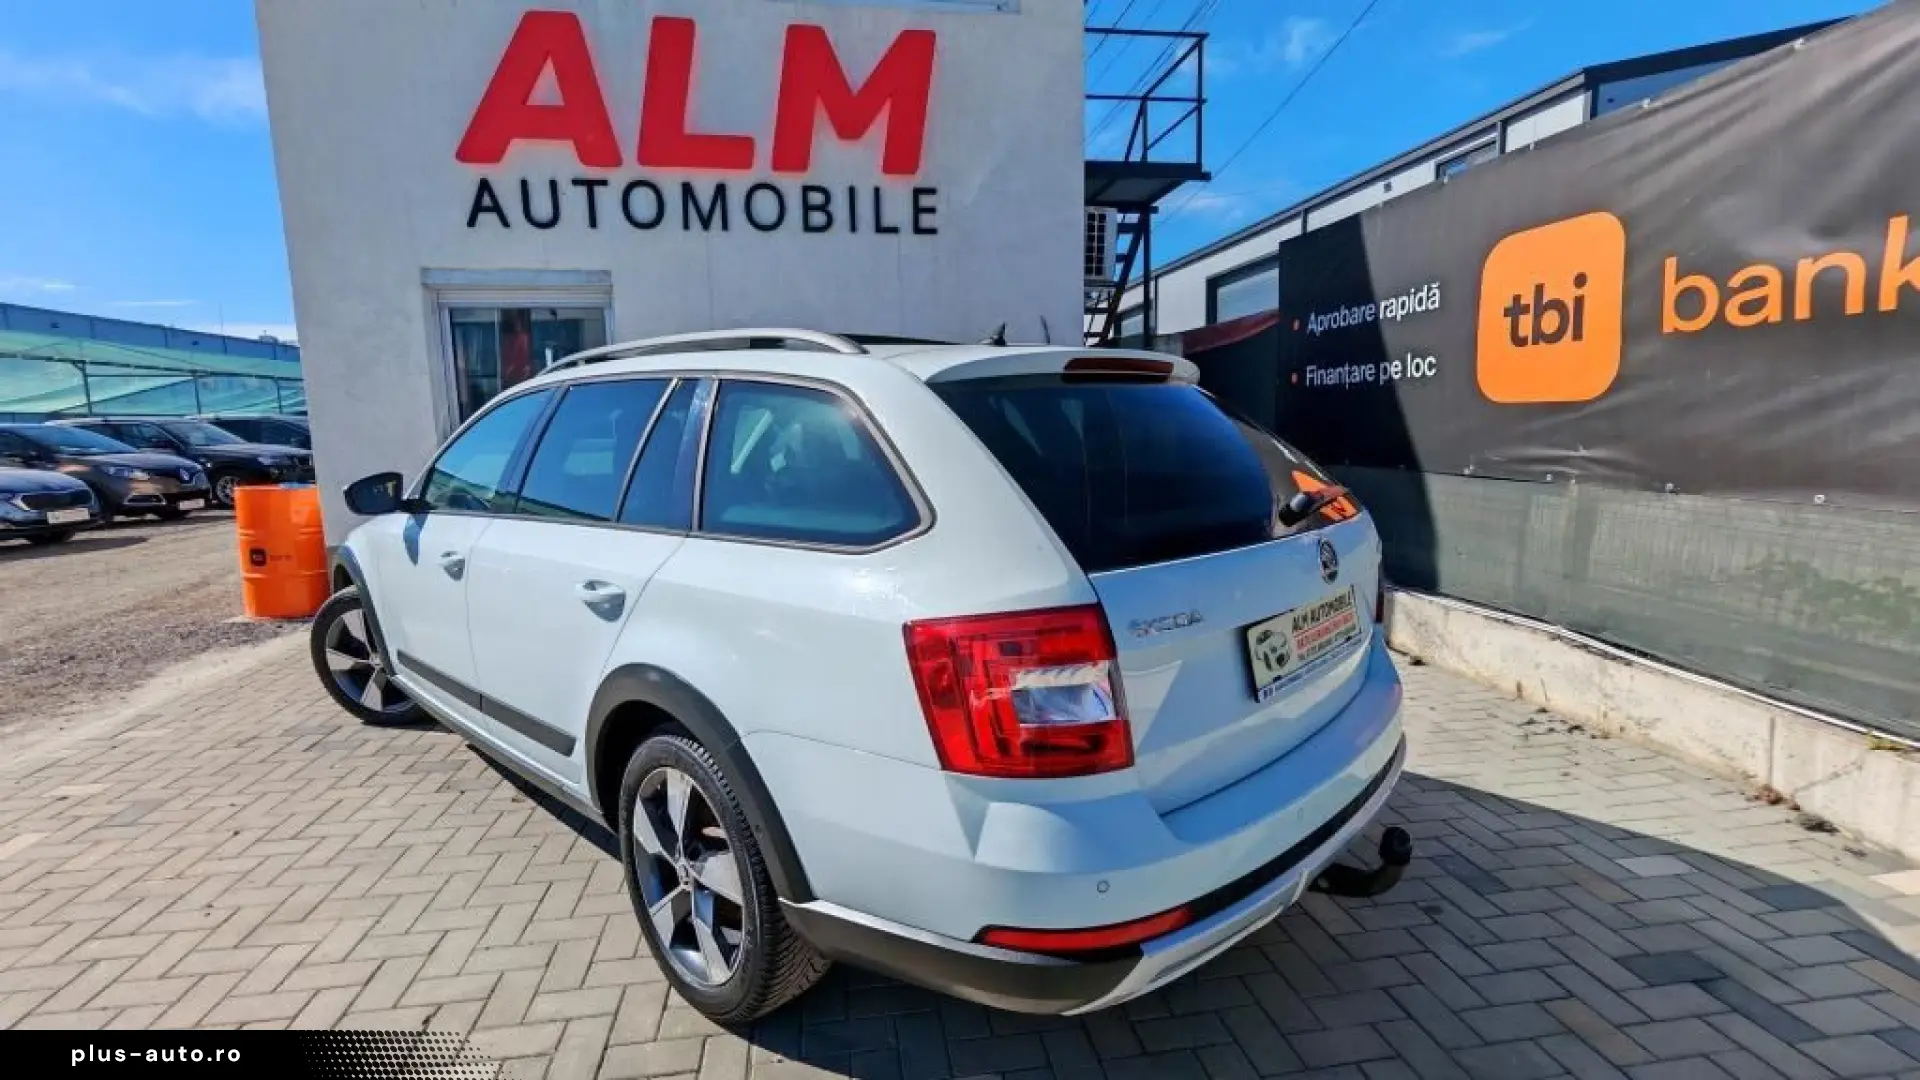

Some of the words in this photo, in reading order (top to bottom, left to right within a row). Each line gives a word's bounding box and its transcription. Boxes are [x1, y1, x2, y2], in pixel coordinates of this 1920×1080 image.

[456, 10, 937, 176] ALM
[466, 177, 938, 236] AUTOMOBILE
[1307, 302, 1376, 337] Aprobare
[1379, 281, 1441, 321] rapidă
[1503, 272, 1588, 348] tbi
[1662, 215, 1920, 335] bank
[1380, 359, 1402, 386] pe
[1407, 352, 1437, 378] loc
